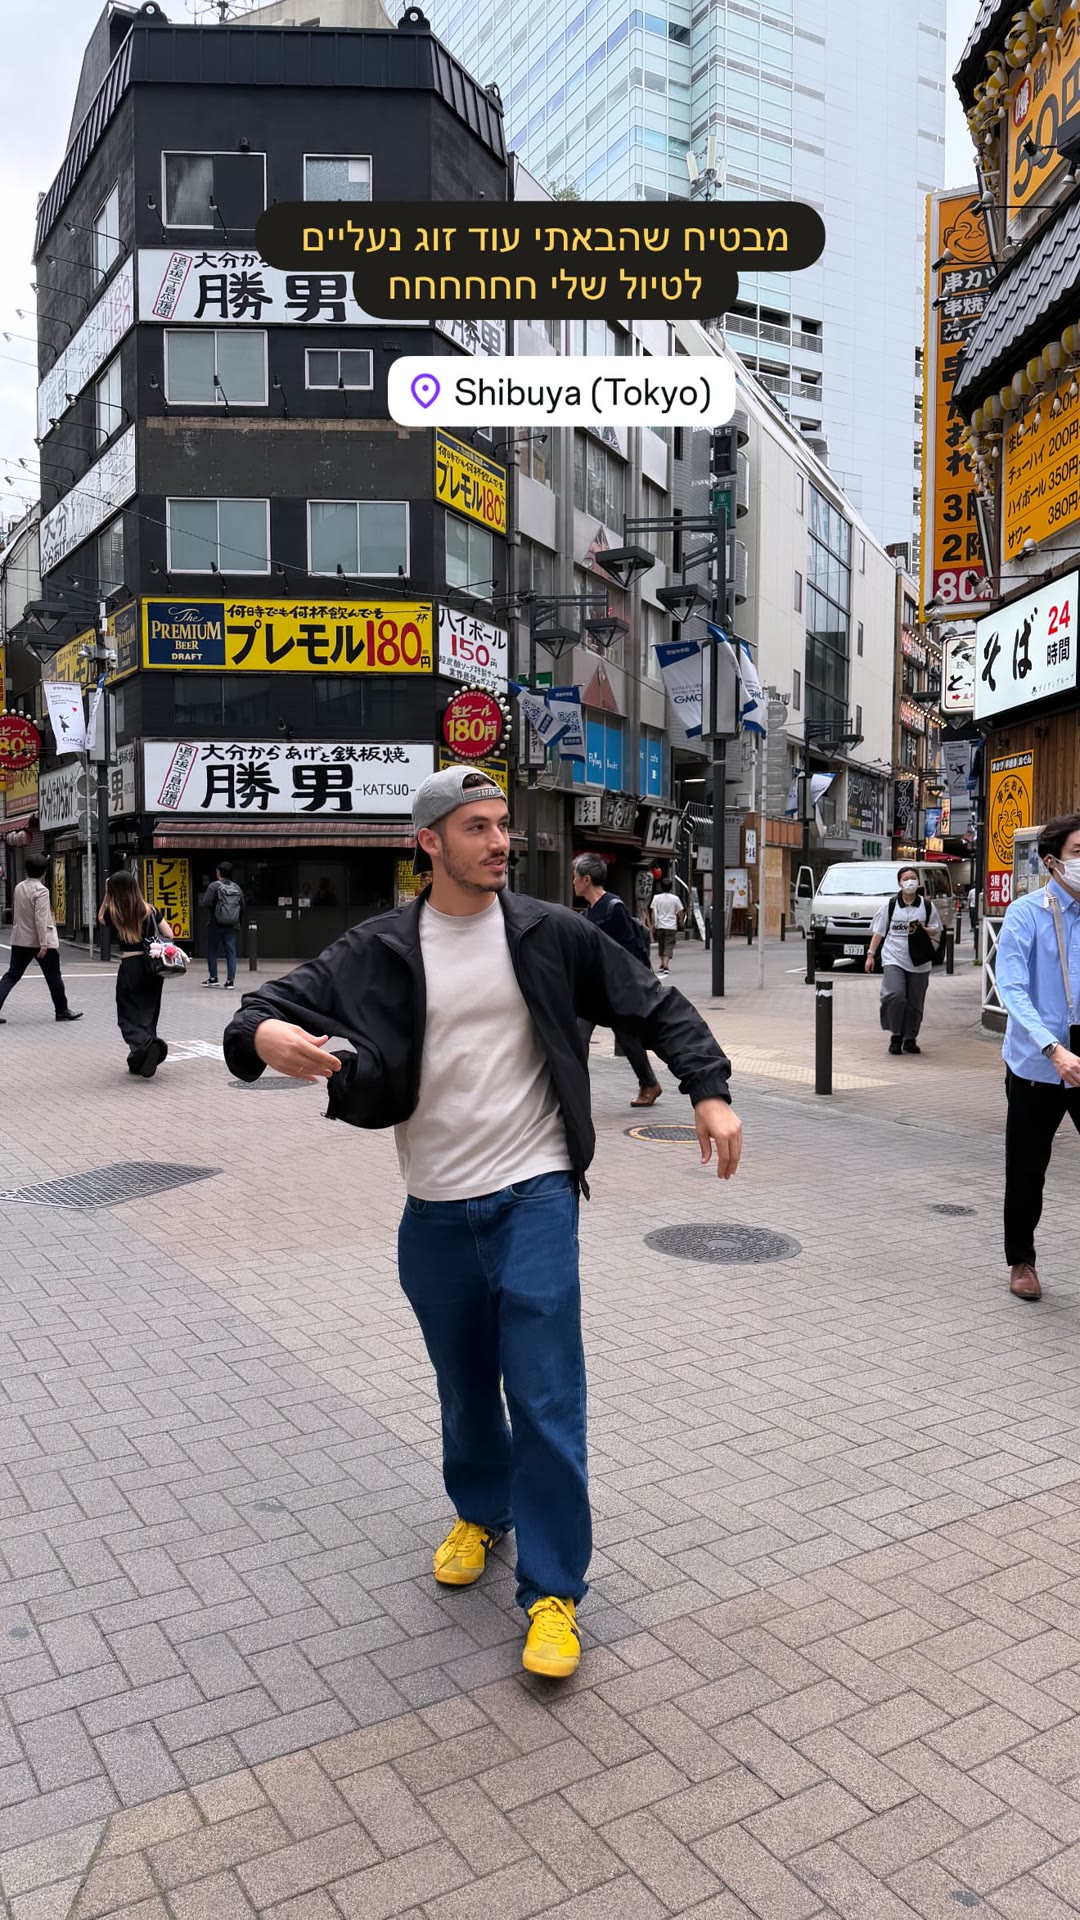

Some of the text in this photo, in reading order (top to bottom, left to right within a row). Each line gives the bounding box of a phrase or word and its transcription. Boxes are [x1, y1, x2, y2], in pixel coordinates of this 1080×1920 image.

[194, 271, 348, 322] 勝男
[1008, 418, 1079, 485] チューハイ 200円
[1008, 454, 1079, 518] ハイボール 350円
[1008, 489, 1079, 549] サワー 380円
[226, 604, 384, 620] 何時でも何杯飲んでも
[1047, 600, 1071, 636] 24
[151, 622, 222, 642] PREMIUM
[439, 608, 506, 650] ハイボール
[171, 652, 203, 662] DRAFT
[175, 639, 200, 651] BEER
[981, 606, 1038, 692] そば
[1046, 636, 1070, 667] 時間
[452, 704, 492, 719] 生ビール
[0, 726, 31, 738] ビール
[447, 718, 497, 742] 180円
[201, 743, 410, 765] 大分からあげと鉄板焼
[201, 761, 354, 812] 勝男
[477, 788, 496, 797] JAPAN
[157, 857, 179, 921] プレモル
